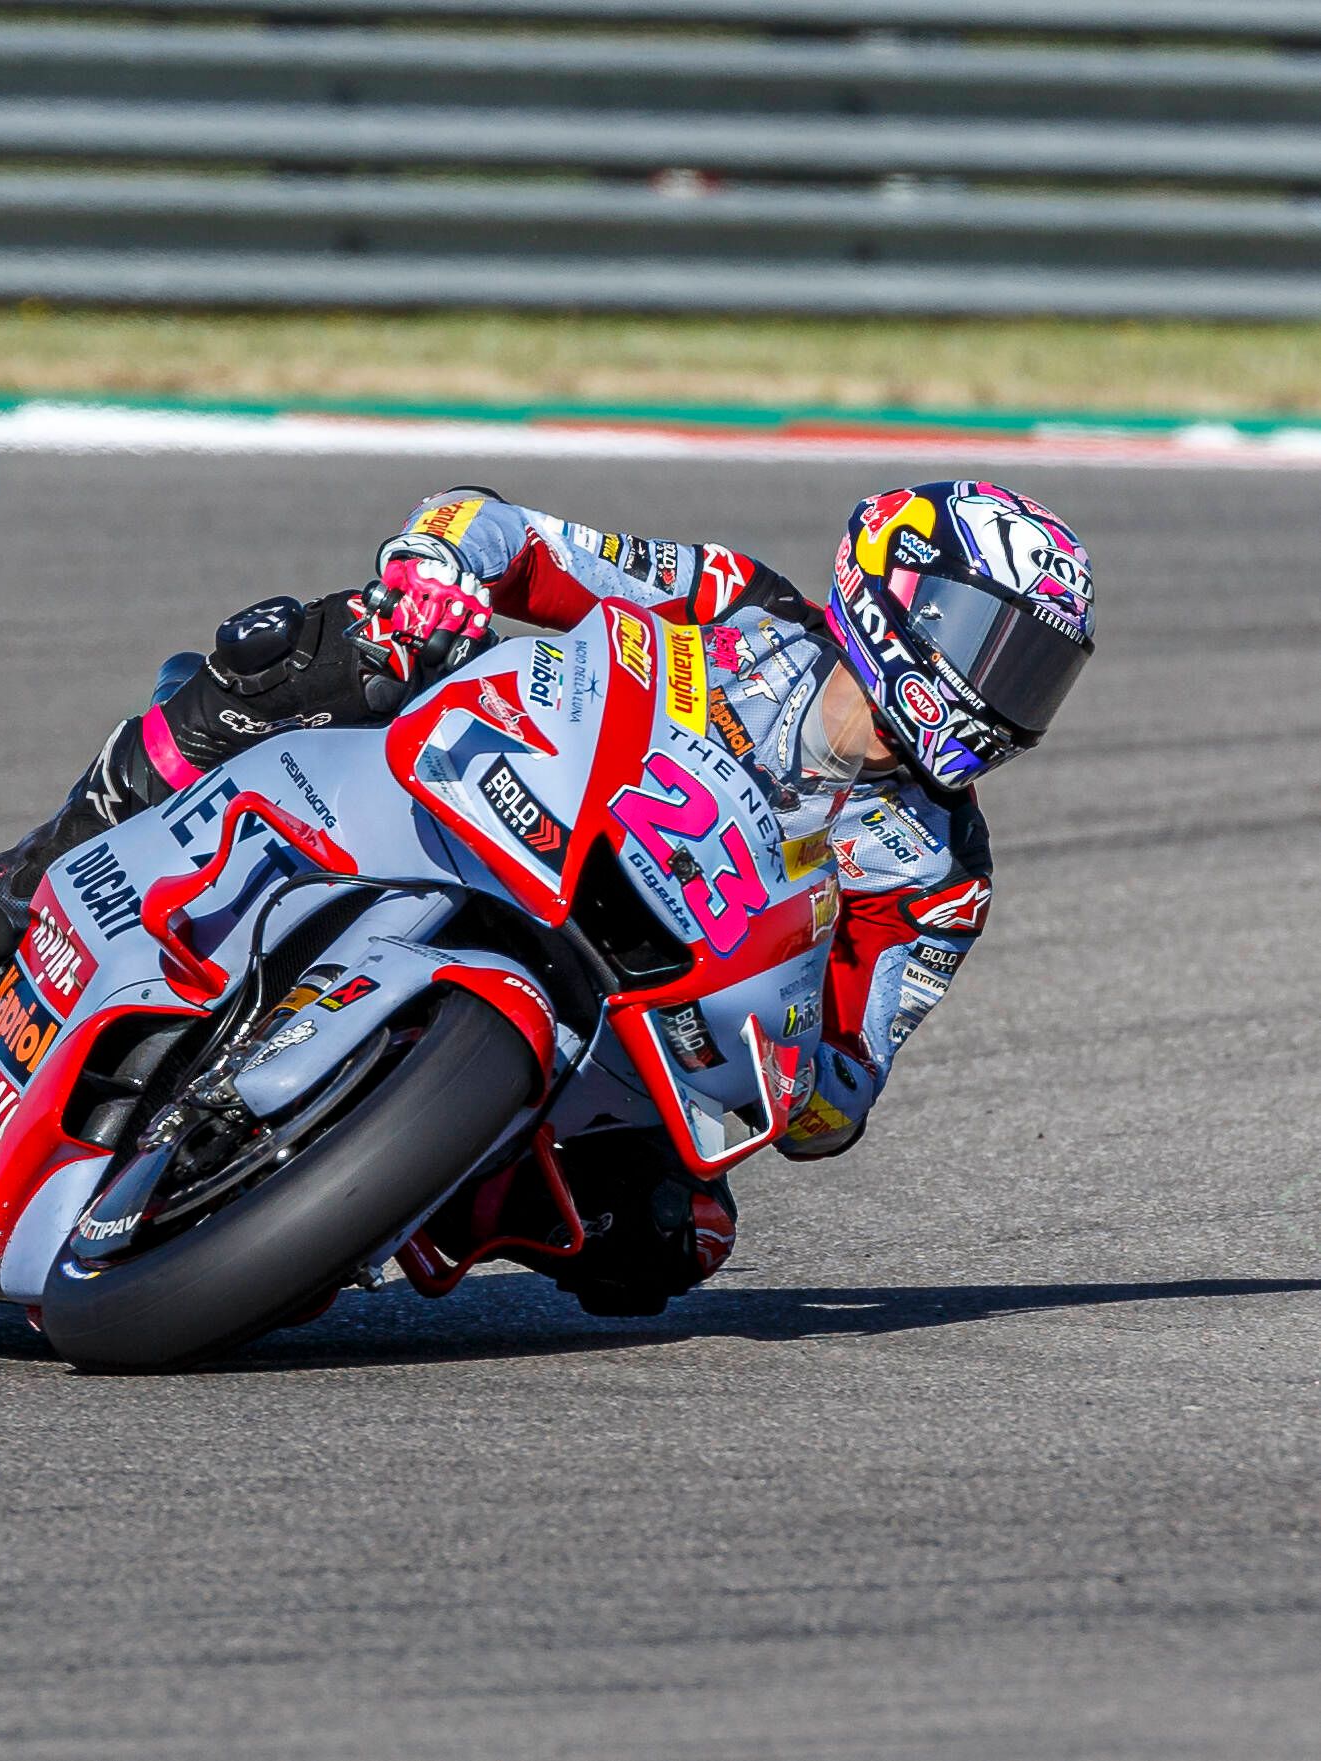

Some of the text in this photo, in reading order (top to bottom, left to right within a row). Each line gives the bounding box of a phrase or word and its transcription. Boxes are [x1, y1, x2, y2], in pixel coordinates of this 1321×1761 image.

[424, 501, 464, 536] tangin
[1035, 549, 1093, 596] KYT
[852, 589, 915, 665] KYT
[529, 639, 565, 707] Unibat
[574, 664, 585, 692] DELLA
[668, 629, 693, 714] Antangin
[937, 659, 986, 711] WHEELUP.IT
[570, 695, 582, 722] LUNA
[907, 683, 940, 723] PATA
[668, 725, 736, 782] THE
[280, 752, 337, 828] GRESINI RACING
[490, 767, 539, 826] BOLD
[607, 749, 769, 958] 23
[860, 808, 921, 865] Unibat
[65, 842, 144, 942] DUCATI
[32, 906, 82, 997] ASPIRA
[920, 946, 958, 966] BOLD
[676, 1006, 706, 1052] BOLD
[81, 1212, 142, 1242] ATTIPAV
